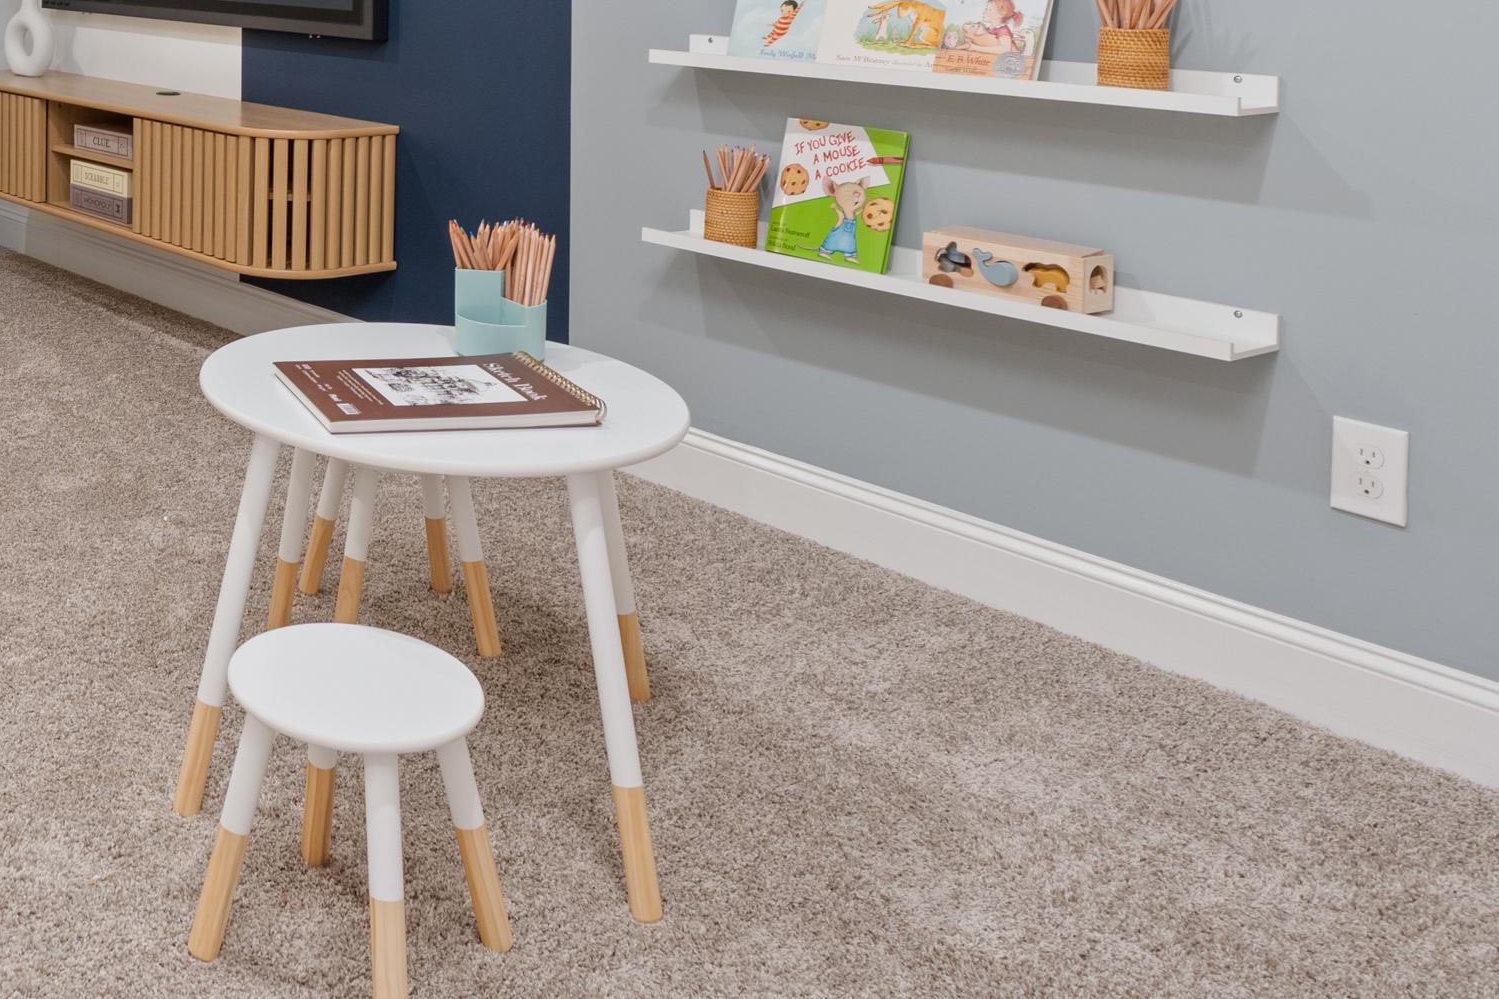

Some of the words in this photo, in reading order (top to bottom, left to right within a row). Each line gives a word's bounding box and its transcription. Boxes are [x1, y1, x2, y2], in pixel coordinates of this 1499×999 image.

[92, 135, 111, 149] CLUE
[794, 141, 805, 155] IF
[807, 135, 827, 151] YOU
[828, 130, 856, 147] GIVE
[813, 153, 820, 165] A
[823, 145, 861, 162] MOUSE
[815, 169, 822, 180] A
[825, 157, 867, 177] COOKIE
